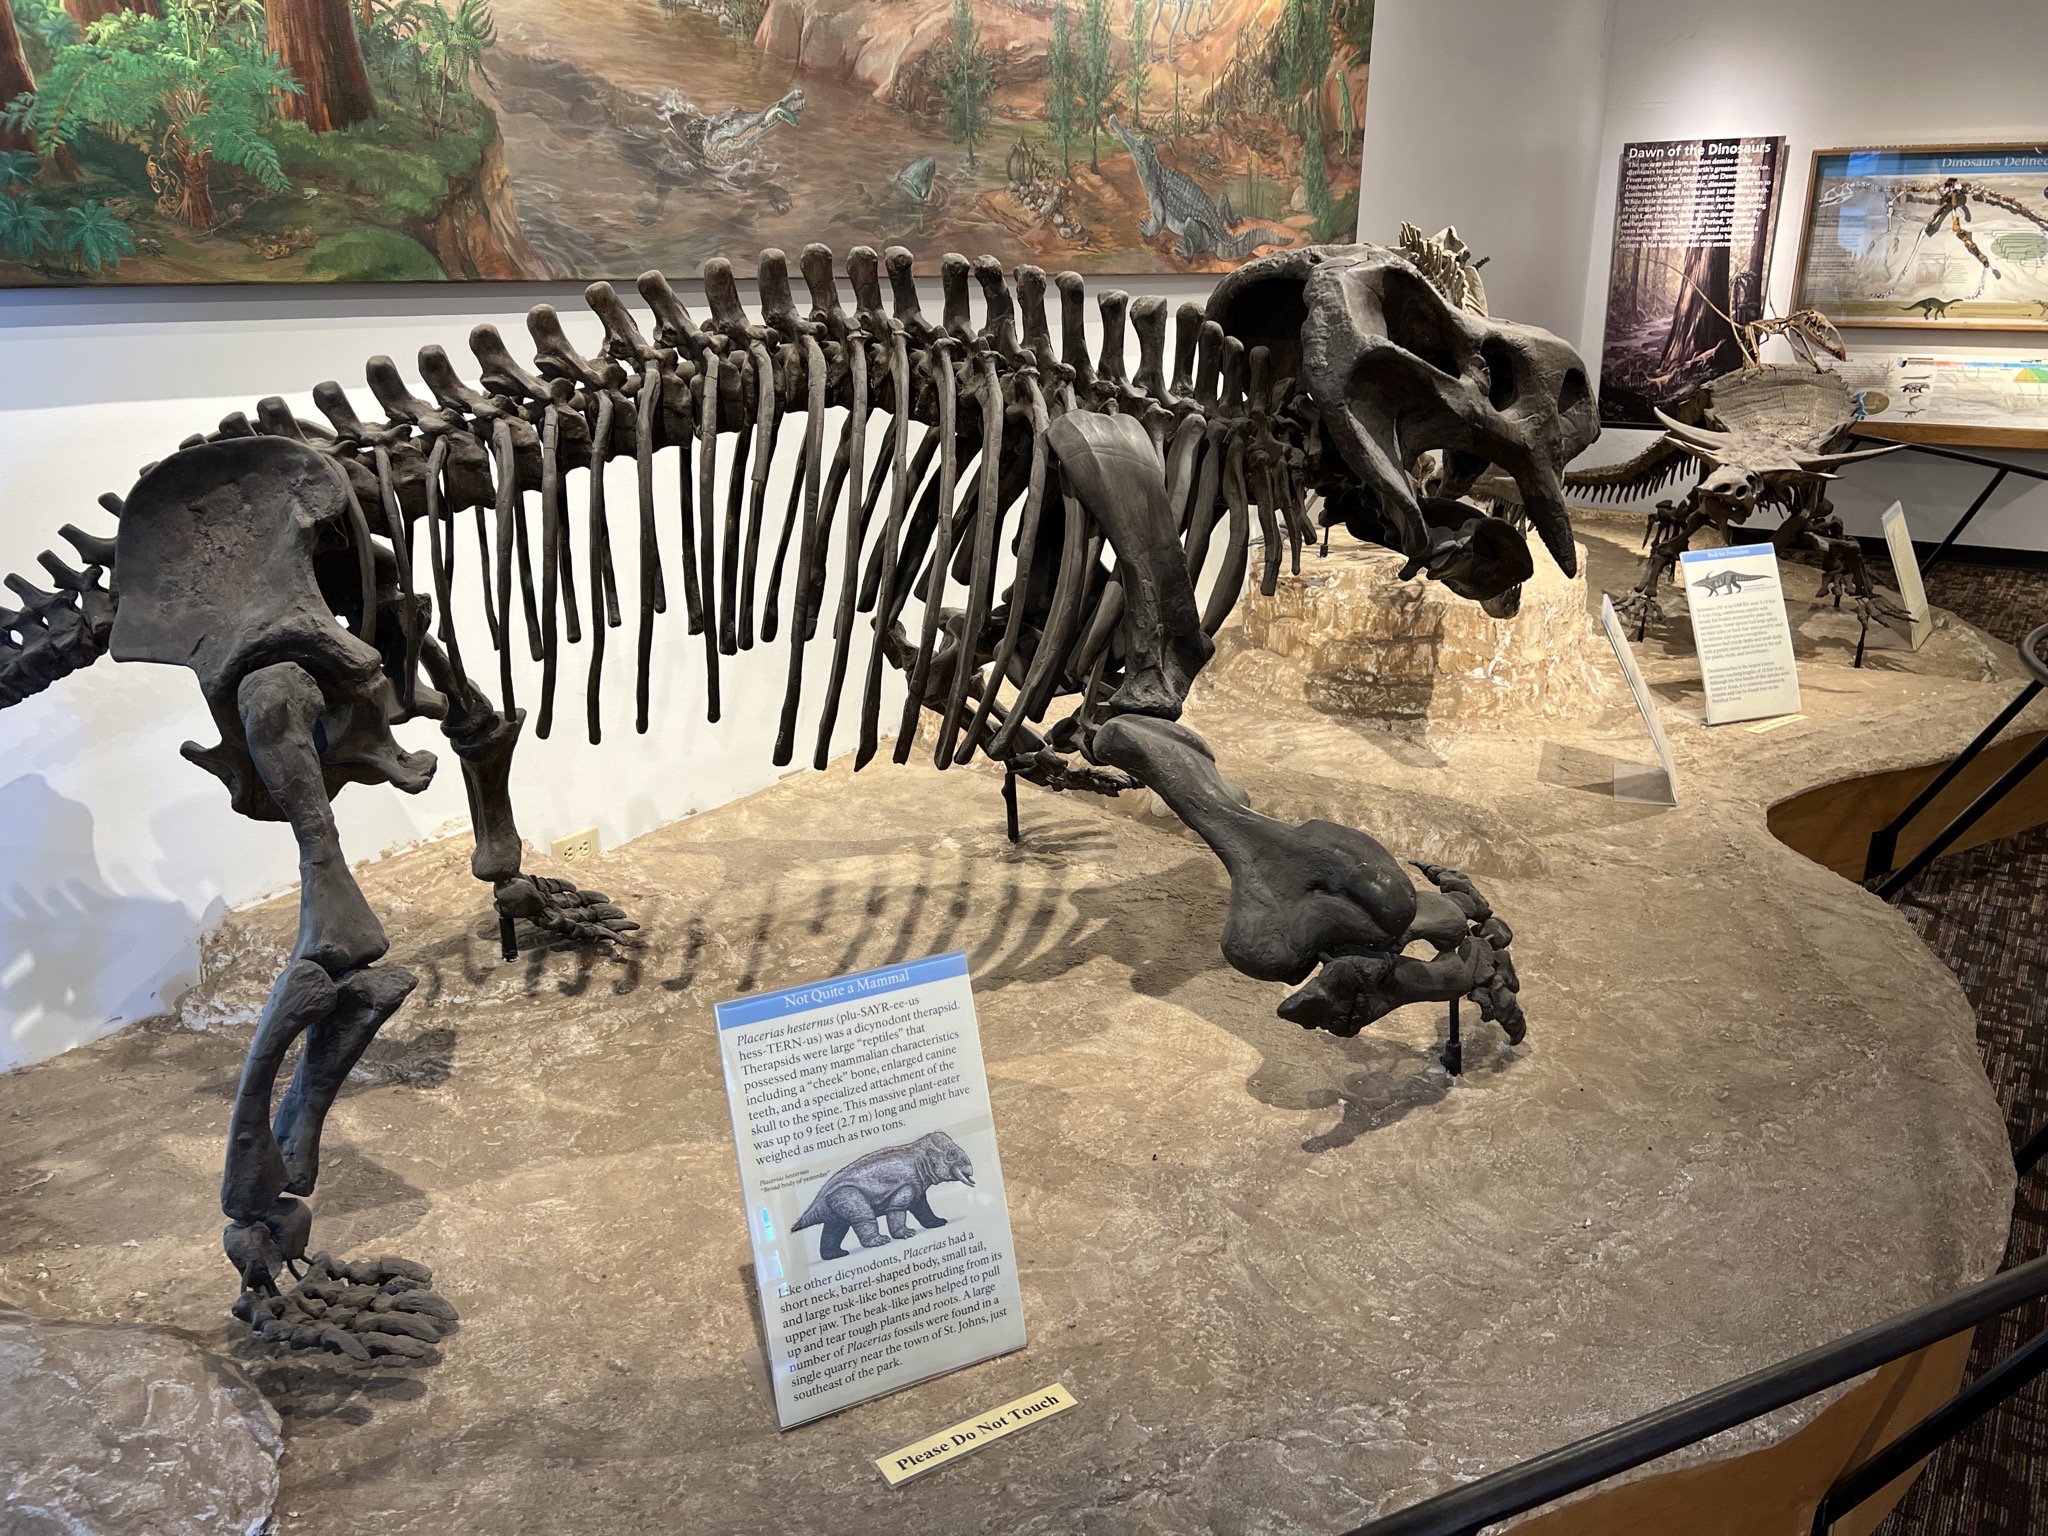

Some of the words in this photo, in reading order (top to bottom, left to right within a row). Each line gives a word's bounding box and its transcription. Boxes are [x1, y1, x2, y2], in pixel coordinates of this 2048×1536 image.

[1630, 148, 1664, 158] Dawn
[1667, 145, 1681, 156] of
[1684, 144, 1705, 156] the
[1708, 143, 1771, 155] Dinosaurs
[1942, 158, 2001, 168] Dinosaurs
[783, 993, 807, 1007] Not
[811, 986, 844, 1003] Quite
[847, 984, 853, 993] a
[857, 969, 909, 991] Mammal
[736, 1028, 784, 1045] Placerias
[785, 1016, 834, 1034] hesternus
[835, 996, 919, 1025] (plu-SAYR-ee-us
[739, 1032, 823, 1060] hess-TERN-us)
[824, 1029, 844, 1040] was
[845, 1027, 852, 1035] a
[853, 1012, 911, 1033] dicynodont
[912, 1000, 960, 1019] therapsid.
[741, 1053, 801, 1075] Therapsids
[802, 1048, 828, 1060] were
[829, 1041, 855, 1054] large
[905, 1023, 925, 1035] that
[744, 1068, 797, 1093] possessed
[799, 1063, 829, 1076] many
[830, 1048, 888, 1069] mammalian
[890, 1031, 959, 1054] characteristics
[746, 1086, 797, 1105] including
[798, 1084, 805, 1092] a
[849, 1066, 879, 1079] bone,
[880, 1052, 923, 1071] enlarged
[924, 1046, 957, 1060] canine
[748, 1104, 779, 1120] teeth,
[781, 1098, 801, 1112] and
[803, 1098, 810, 1106] a
[811, 1081, 867, 1105] specialized
[869, 1067, 925, 1089] attachment
[926, 1063, 938, 1074] of
[938, 1060, 954, 1071] the
[751, 1119, 776, 1135] skull
[778, 1118, 790, 1128] to
[792, 1112, 809, 1124] the
[811, 1106, 842, 1120] spine.
[842, 1097, 866, 1111] This
[868, 1088, 906, 1104] massive
[908, 1074, 960, 1096] plant-eater
[753, 1138, 774, 1150] was
[775, 1134, 791, 1145] up
[792, 1130, 804, 1140] to
[805, 1125, 813, 1136] 9
[814, 1121, 834, 1134] feet
[836, 1114, 856, 1131] (2.7
[857, 1109, 873, 1122] m)
[873, 1105, 897, 1118] long
[897, 1098, 916, 1111] and
[918, 1091, 946, 1106] might
[947, 1086, 970, 1098] have
[756, 1144, 801, 1165] weighed
[802, 1143, 814, 1152] as
[816, 1132, 845, 1149] much
[847, 1131, 858, 1140] as
[859, 1125, 879, 1137] two
[881, 1119, 905, 1131] tons.
[780, 1296, 809, 1313] short
[810, 1287, 839, 1304] neck,
[840, 1263, 911, 1294] barrel-shaped
[912, 1257, 940, 1272] body,
[941, 1246, 966, 1263] small
[968, 1241, 986, 1254] tail,
[782, 1312, 803, 1328] and
[804, 1306, 830, 1321] large
[832, 1291, 877, 1312] tusk-like
[878, 1281, 909, 1297] bones
[910, 1264, 965, 1290] protruding
[965, 1256, 989, 1269] from
[990, 1252, 1002, 1261] its
[803, 1275, 833, 1290] other
[833, 1255, 901, 1281] dicynodonts,
[902, 1240, 946, 1259] Placerias
[947, 1231, 966, 1245] had
[967, 1231, 974, 1239] a
[784, 1326, 817, 1344] upper
[818, 1320, 838, 1335] jaw.
[839, 1311, 861, 1325] The
[862, 1296, 909, 1317] beak-like
[910, 1289, 933, 1304] jaws
[934, 1275, 968, 1294] helped
[969, 1273, 980, 1283] to
[981, 1264, 1000, 1282] pull
[787, 1347, 802, 1358] up
[803, 1337, 823, 1352] and
[825, 1332, 847, 1345] tear
[848, 1319, 877, 1338] tough
[879, 1311, 910, 1330] plants
[911, 1302, 931, 1317] and
[932, 1295, 961, 1310] roots.
[961, 1289, 971, 1300] A
[971, 1283, 995, 1297] large
[789, 1352, 831, 1372] number
[833, 1344, 845, 1357] of
[845, 1332, 892, 1353] Placerias
[892, 1320, 924, 1337] fossils
[925, 1313, 949, 1327] were
[950, 1300, 980, 1318] found
[981, 1298, 991, 1308] in
[992, 1296, 999, 1304] a
[791, 1370, 822, 1387] single
[823, 1358, 859, 1379] quarry
[859, 1350, 884, 1364] near
[885, 1343, 901, 1355] the
[903, 1334, 929, 1349] town
[931, 1327, 943, 1340] of
[943, 1325, 956, 1336] St.
[956, 1315, 988, 1333] Johns,
[989, 1307, 1007, 1323] just
[793, 1376, 843, 1401] southeast
[844, 1370, 857, 1383] of
[857, 1366, 874, 1379] the
[876, 1355, 902, 1375] park.
[895, 1443, 950, 1471] Please
[950, 1431, 977, 1446] Do
[976, 1417, 1010, 1434] Not
[1007, 1395, 1060, 1420] Touch
